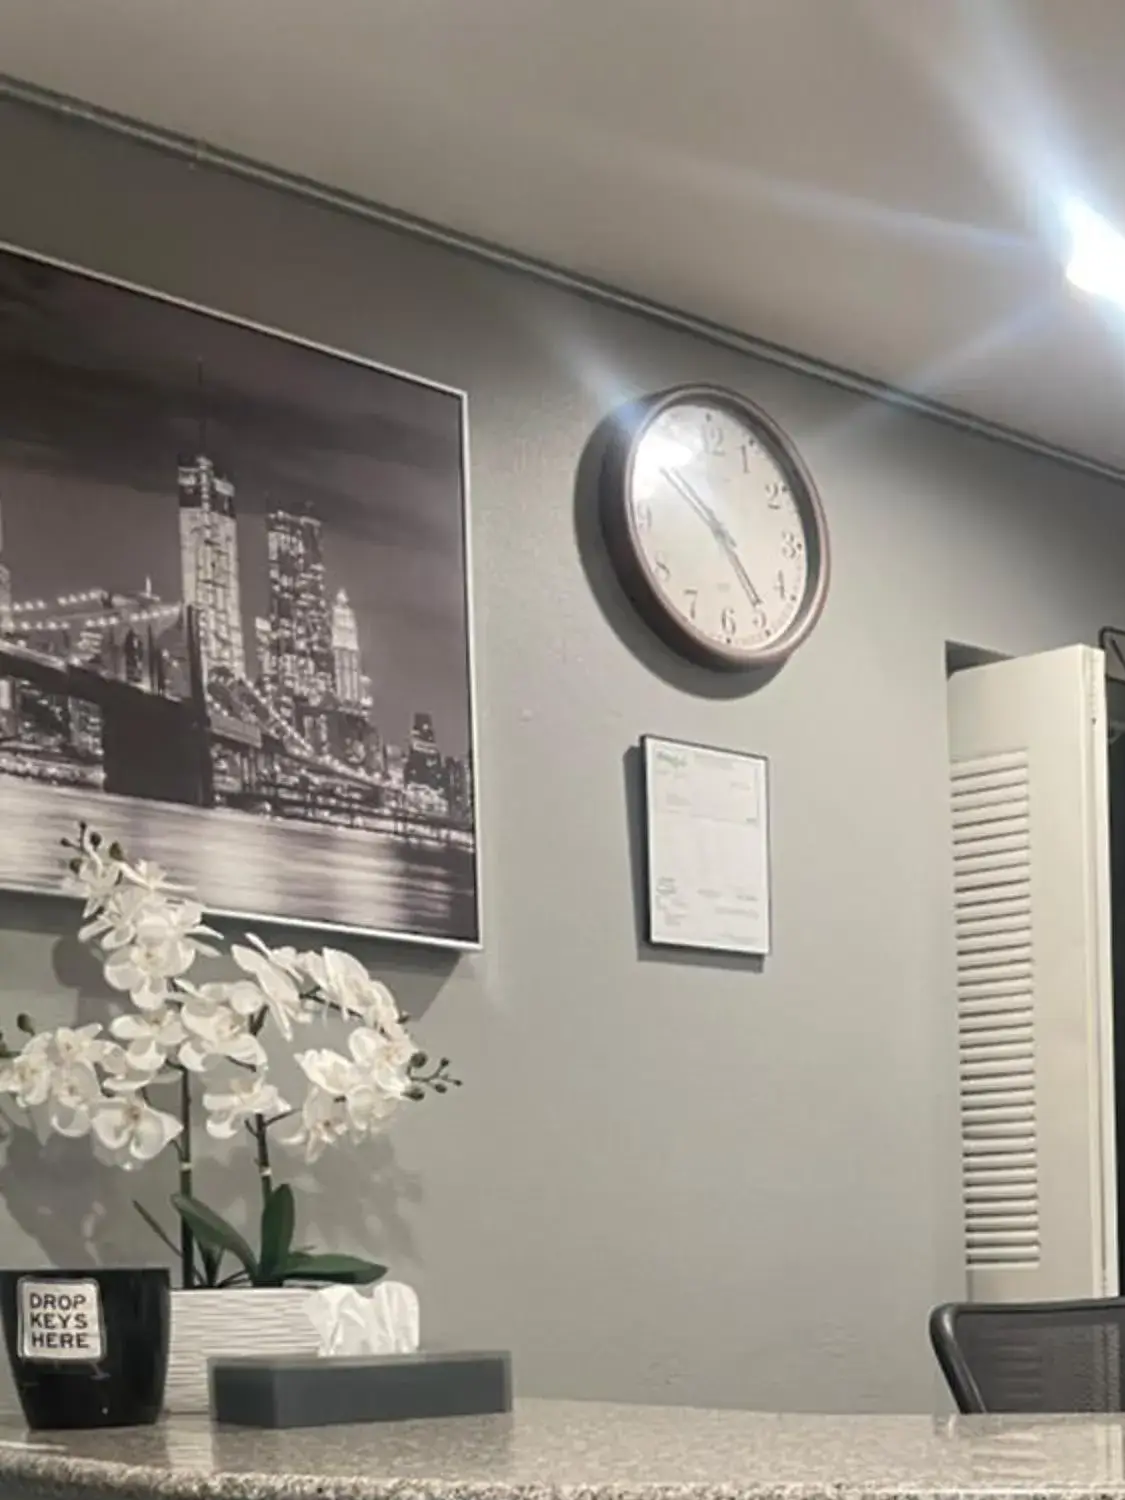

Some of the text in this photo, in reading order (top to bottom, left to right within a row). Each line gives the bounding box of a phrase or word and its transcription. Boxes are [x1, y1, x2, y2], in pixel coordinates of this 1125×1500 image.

[737, 445, 751, 474] 1
[765, 485, 780, 510] 2
[782, 531, 797, 559] 3
[684, 589, 698, 619] 7
[721, 608, 737, 636] 6
[29, 1292, 87, 1310] DROP
[29, 1312, 89, 1329] KEYS
[31, 1332, 90, 1348] HERE
